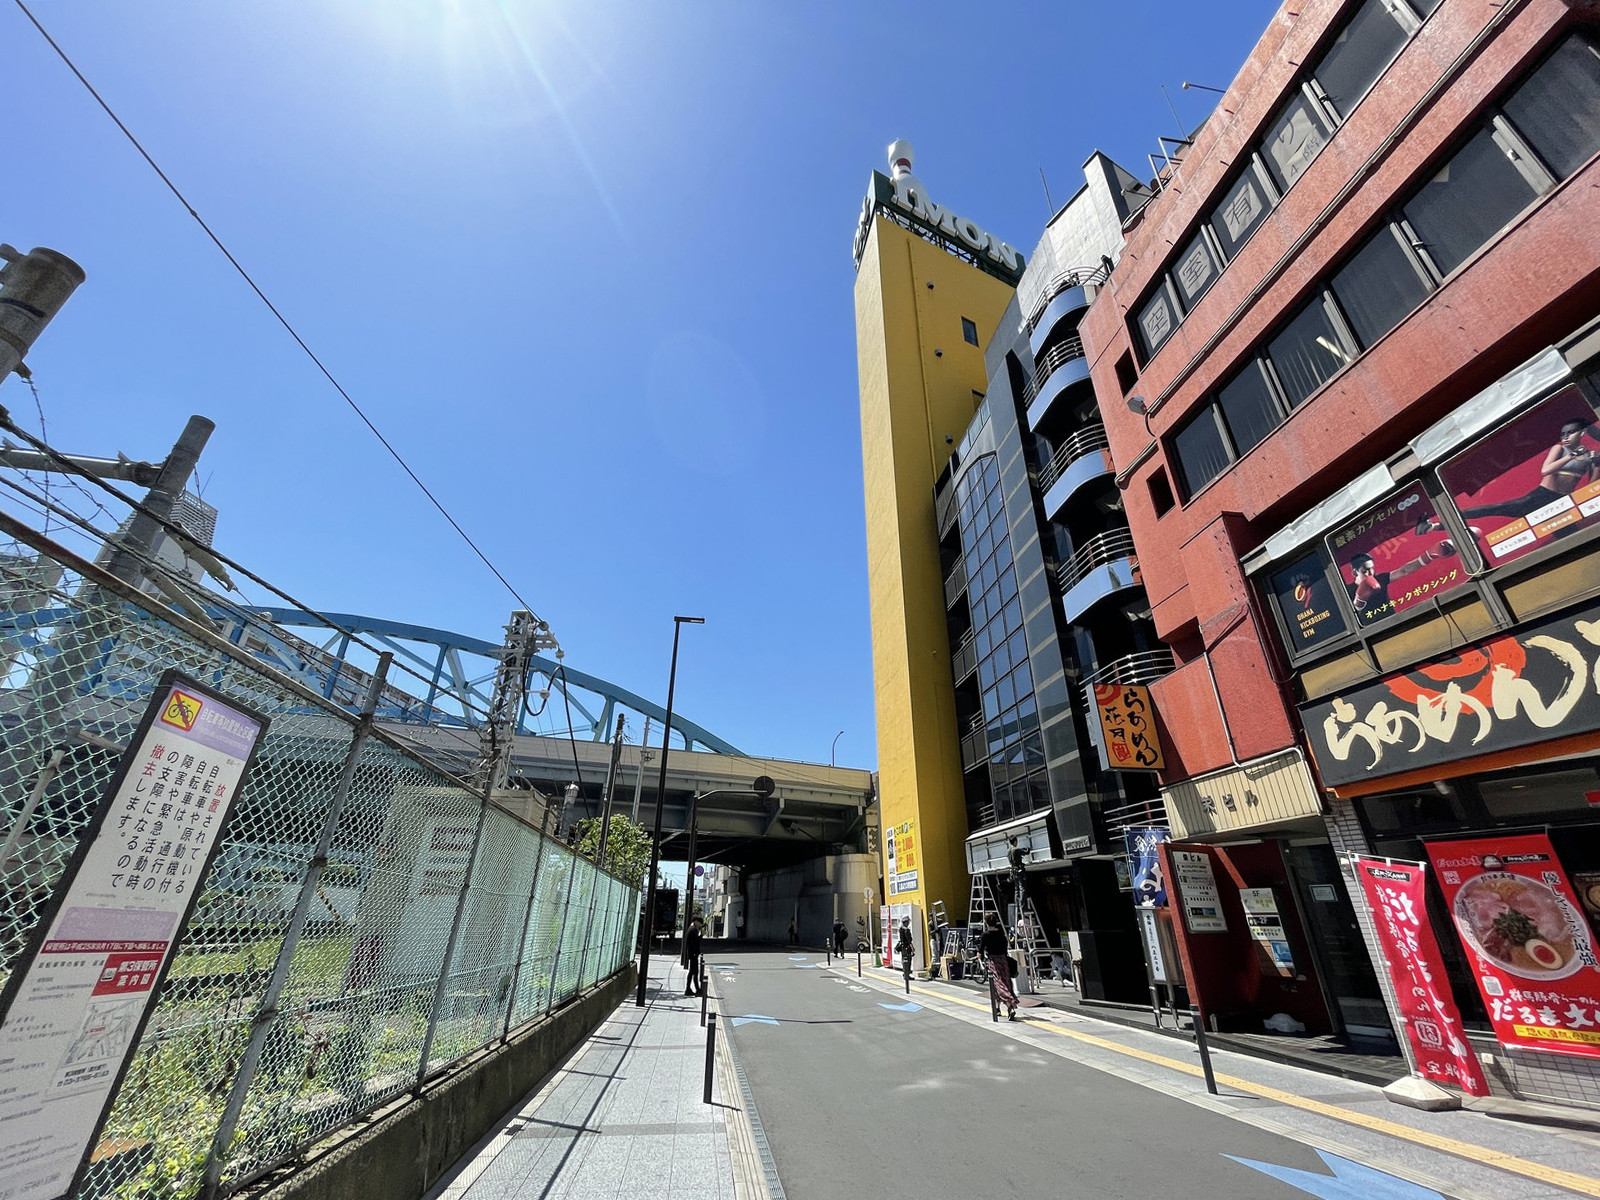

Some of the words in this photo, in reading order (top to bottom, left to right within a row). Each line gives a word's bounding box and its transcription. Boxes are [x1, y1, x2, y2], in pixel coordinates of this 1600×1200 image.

[1335, 506, 1397, 548] 酸素カプセル
[1297, 608, 1314, 621] OHANA
[1365, 569, 1458, 619] オハナキックボクシング
[1300, 610, 1331, 629] KICKBOXING
[1302, 628, 1315, 638] GYM
[118, 743, 166, 838] 撤去します。
[111, 751, 180, 888] の支障になるので
[125, 754, 195, 890] 障害や緊急活動時
[143, 760, 208, 891] 自転車は、通行の
[158, 765, 220, 893] 自転車や原動機付
[175, 783, 227, 894] 放置されている
[1490, 998, 1600, 1028] だるま大
[1509, 988, 1599, 1004] 群馬豚骨らーめん
